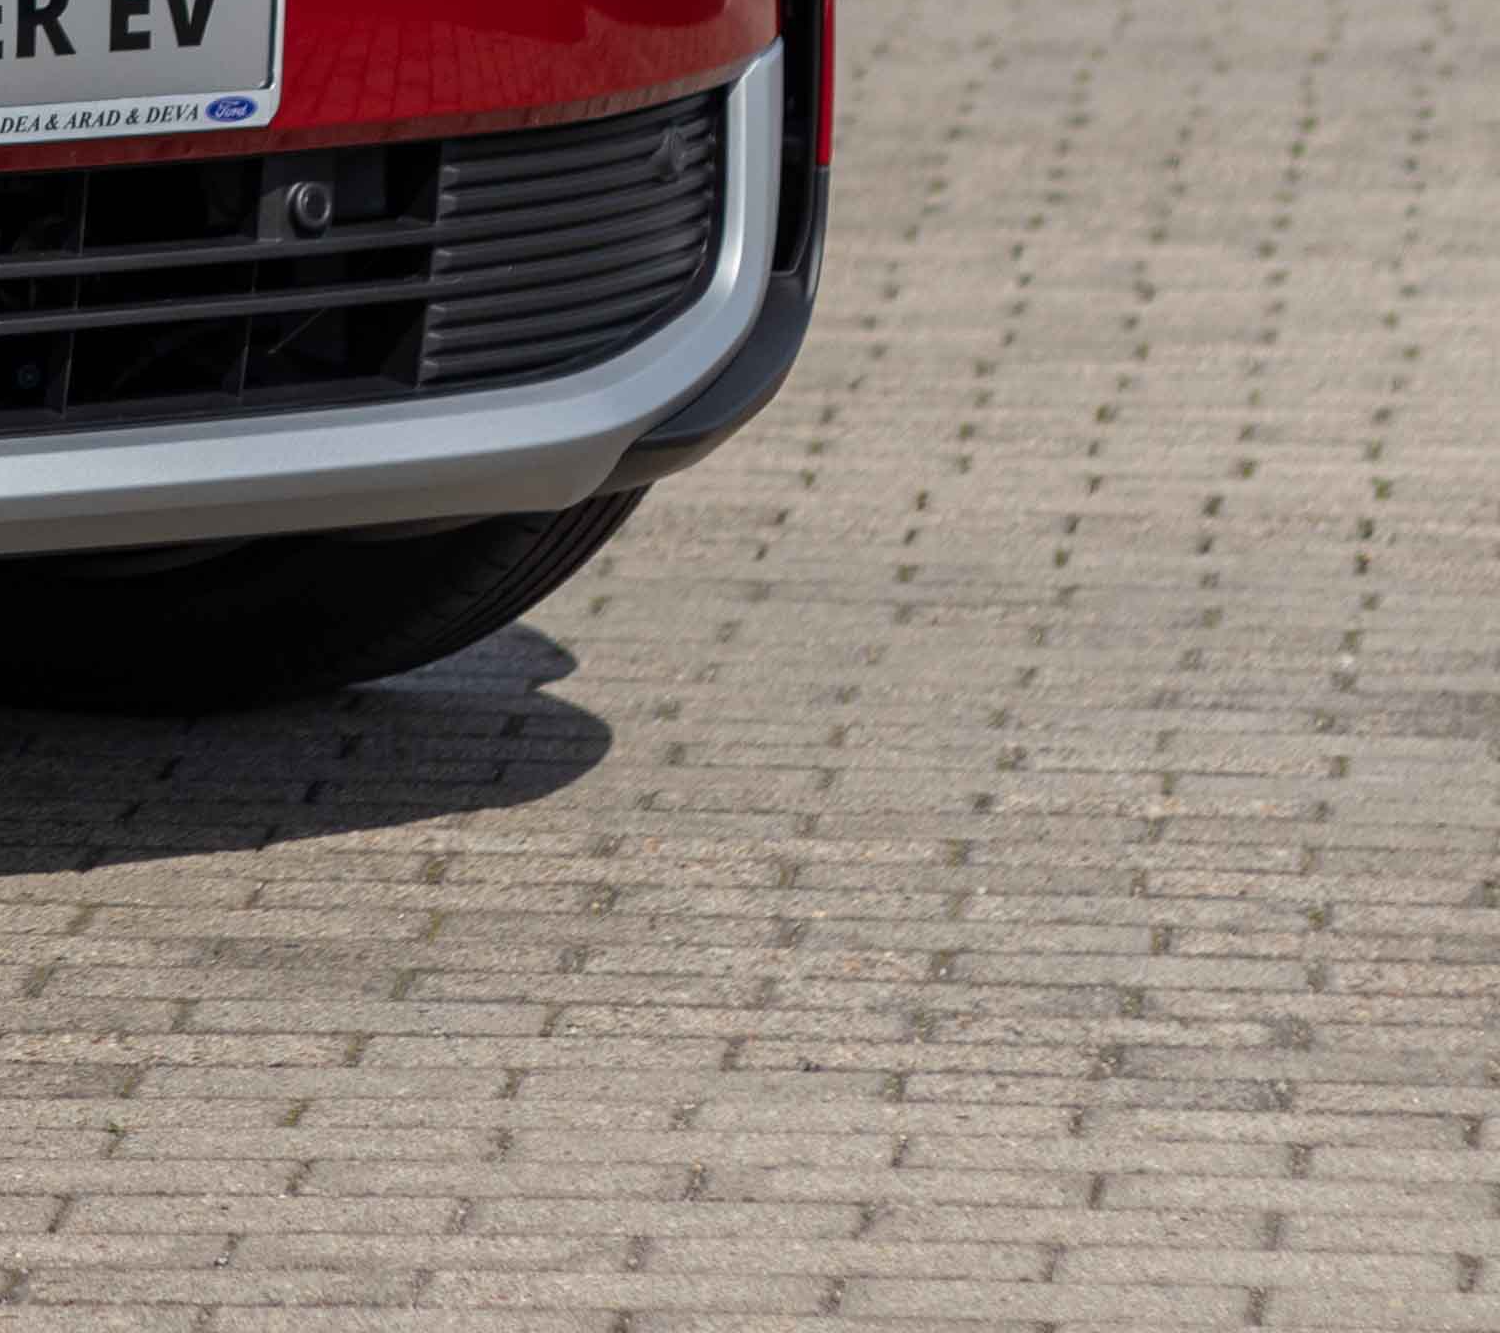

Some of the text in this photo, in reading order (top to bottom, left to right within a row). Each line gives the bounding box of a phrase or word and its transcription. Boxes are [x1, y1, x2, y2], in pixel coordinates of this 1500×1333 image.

[44, 113, 58, 131] &
[63, 108, 121, 130] ARAD
[125, 107, 140, 126] &
[145, 103, 200, 124] DEVA
